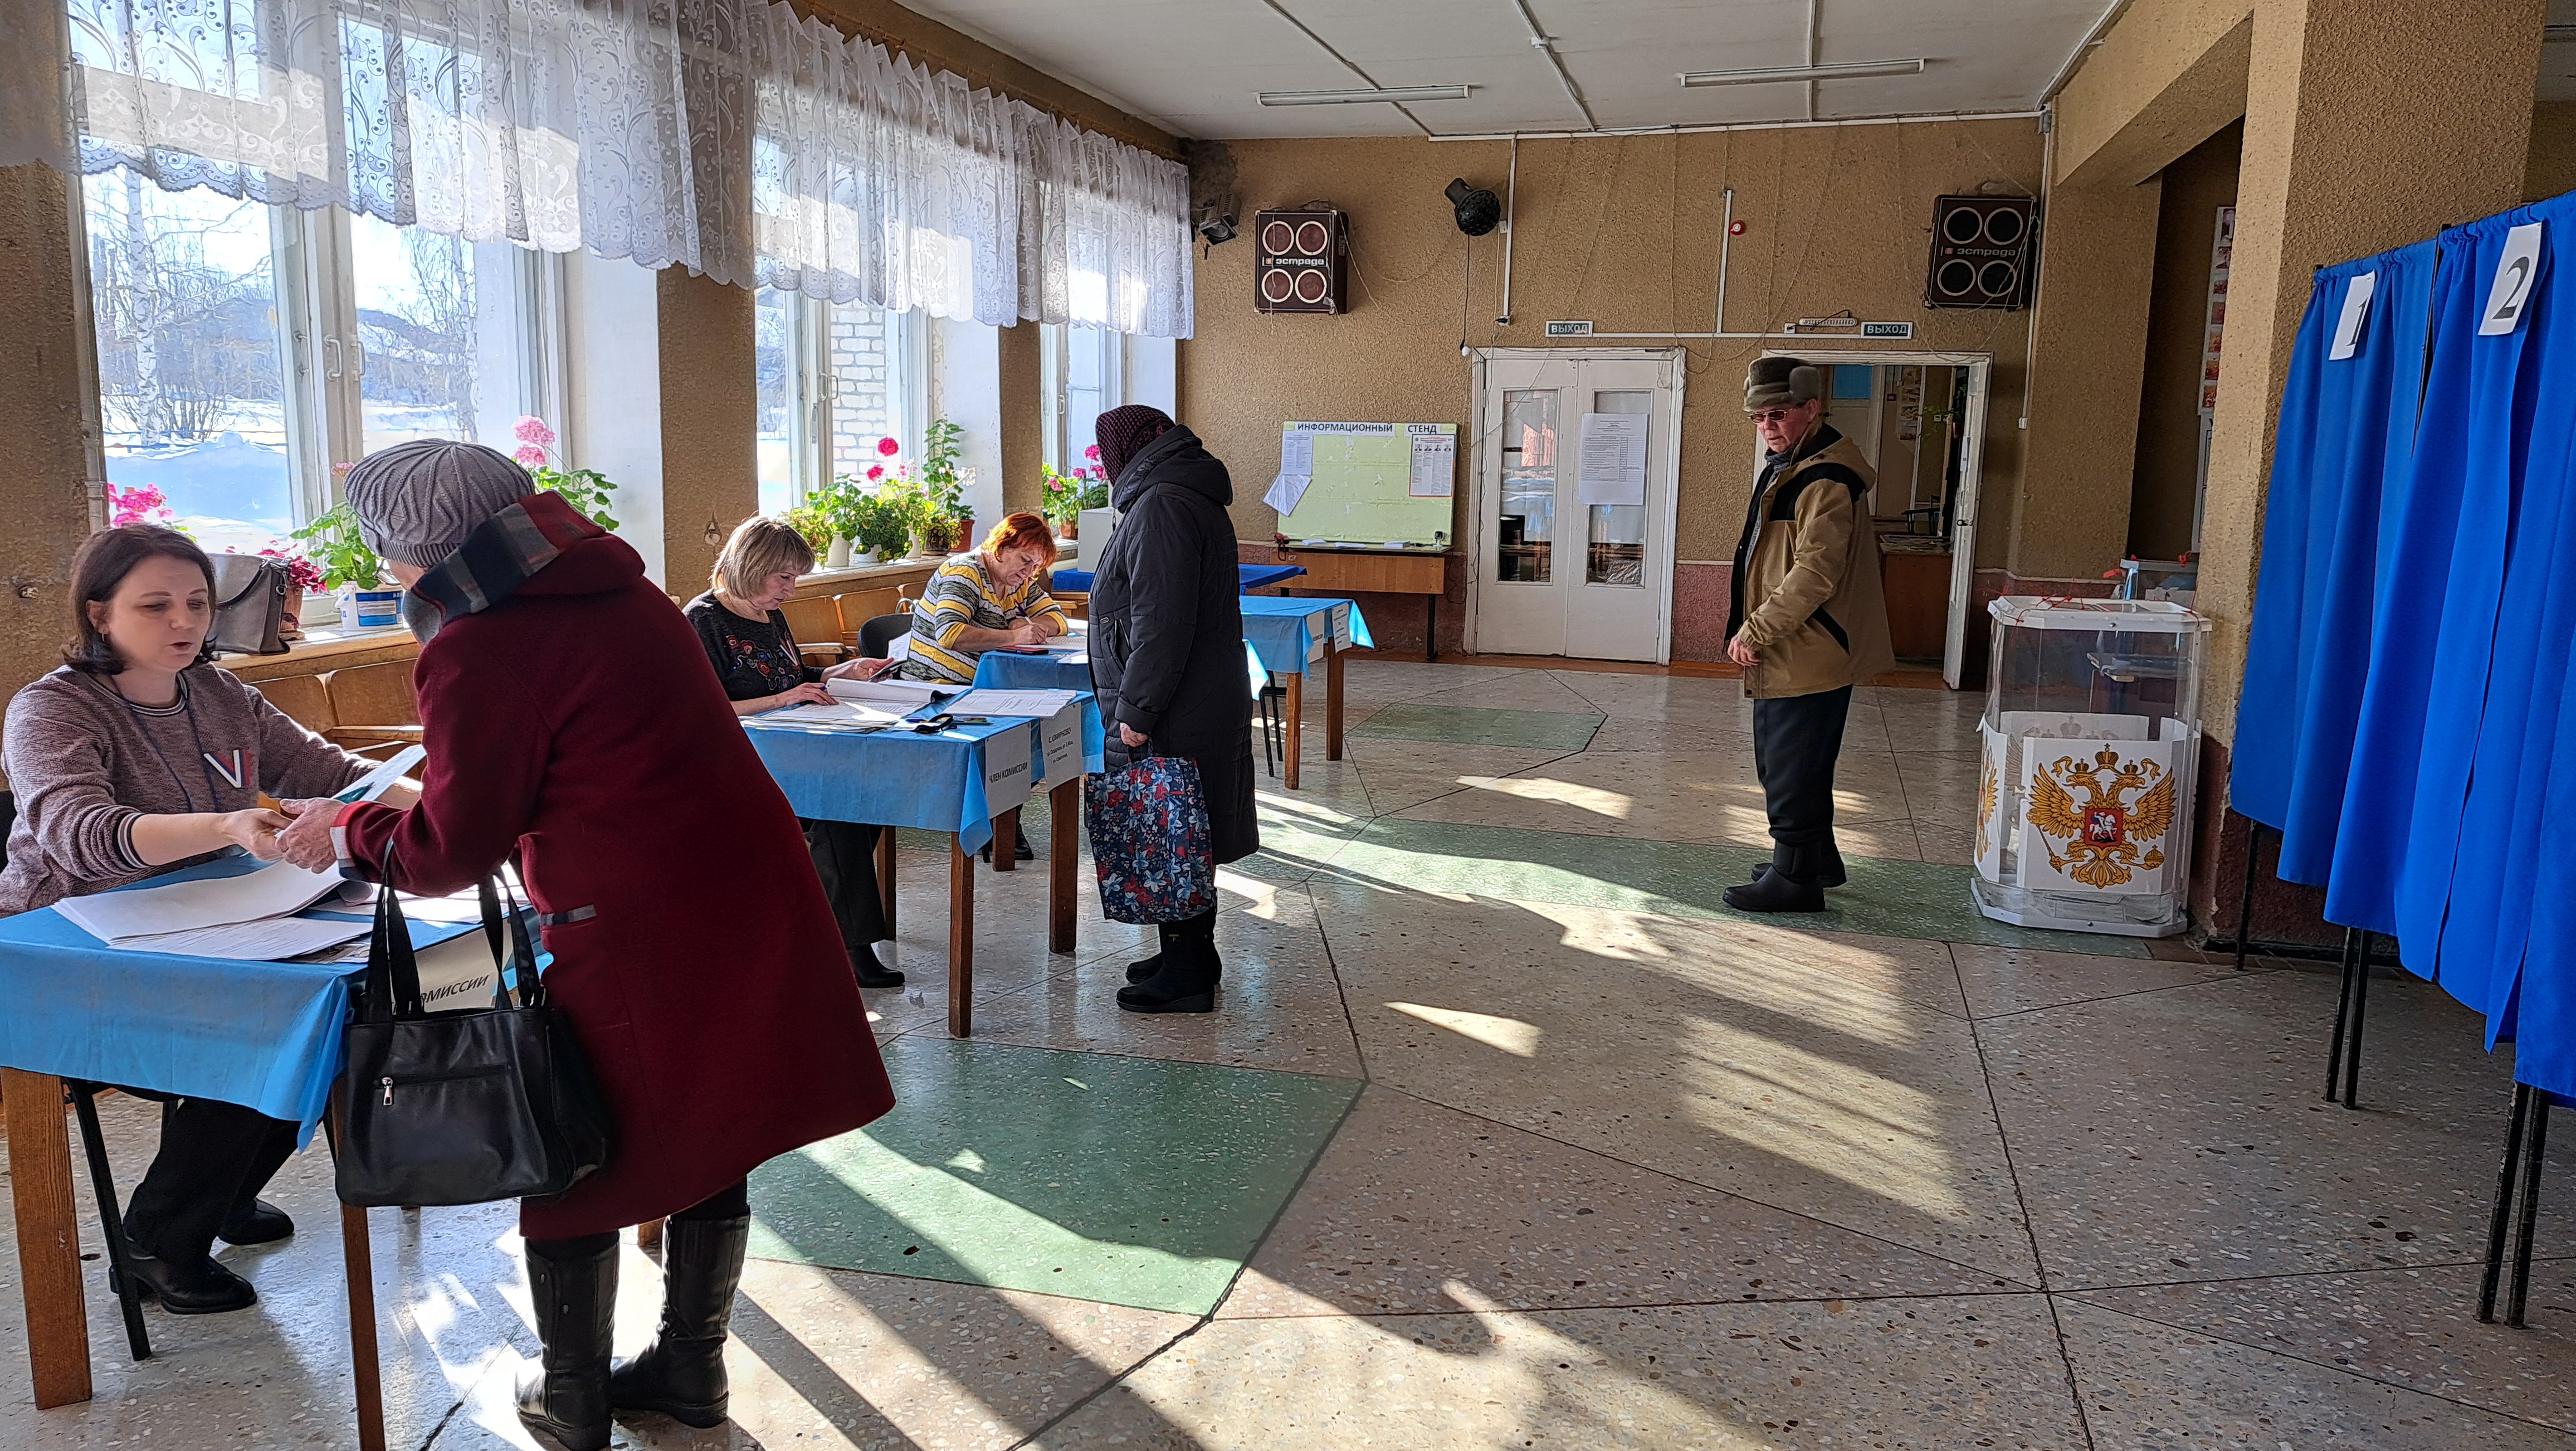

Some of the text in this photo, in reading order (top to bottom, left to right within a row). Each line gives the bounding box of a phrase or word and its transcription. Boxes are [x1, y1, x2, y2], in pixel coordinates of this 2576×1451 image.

[2491, 257, 2530, 320] 2
[1551, 324, 1588, 334] ВЫХОД
[1867, 325, 1907, 334] ВЫХОД
[2346, 298, 2368, 347] 1
[1297, 422, 1437, 435] ИНФОРМАЦИОННЫЙ СТЕНД
[989, 761, 1028, 783] ЧЛЕН КОМИССИИ
[421, 975, 489, 1003] ОМИССИИ
